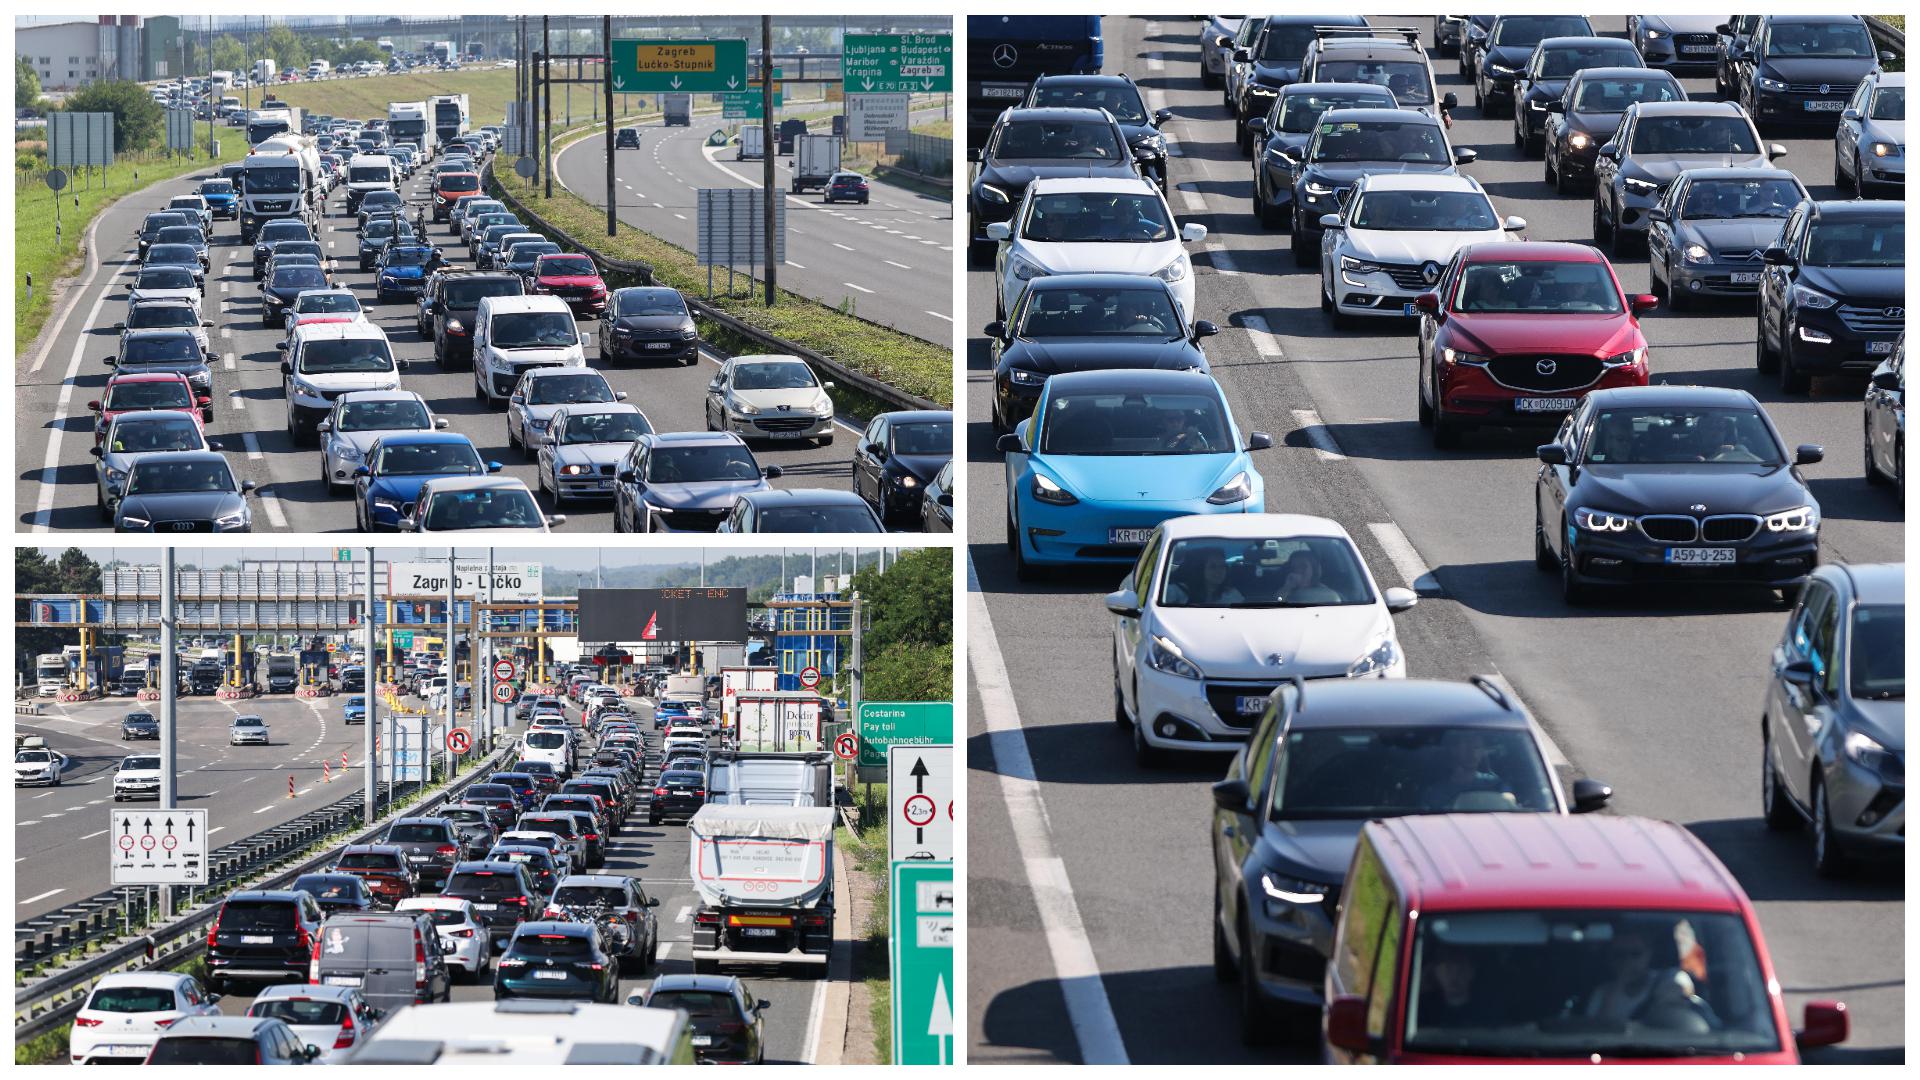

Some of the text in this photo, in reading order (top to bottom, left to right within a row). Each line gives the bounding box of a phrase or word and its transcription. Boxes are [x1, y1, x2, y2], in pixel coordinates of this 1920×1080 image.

[915, 36, 936, 44] Brod
[657, 47, 696, 57] Zagreb
[846, 45, 886, 55] Ljubljana
[901, 46, 942, 55] Budapest
[846, 58, 879, 66] Maribor
[901, 56, 940, 65] Varaždin
[846, 68, 882, 78] Krapina
[900, 66, 932, 76] Zagreb
[1736, 273, 1747, 282] ZG
[1872, 342, 1884, 352] ZG
[1117, 530, 1131, 541] KR
[413, 575, 462, 592] Zagrb
[707, 588, 729, 598] ENC
[498, 687, 510, 697] 40
[1246, 698, 1260, 711] KR
[863, 709, 906, 718] Cestarina
[863, 722, 896, 732] Pay toll
[863, 736, 934, 744] Autobahngebühr
